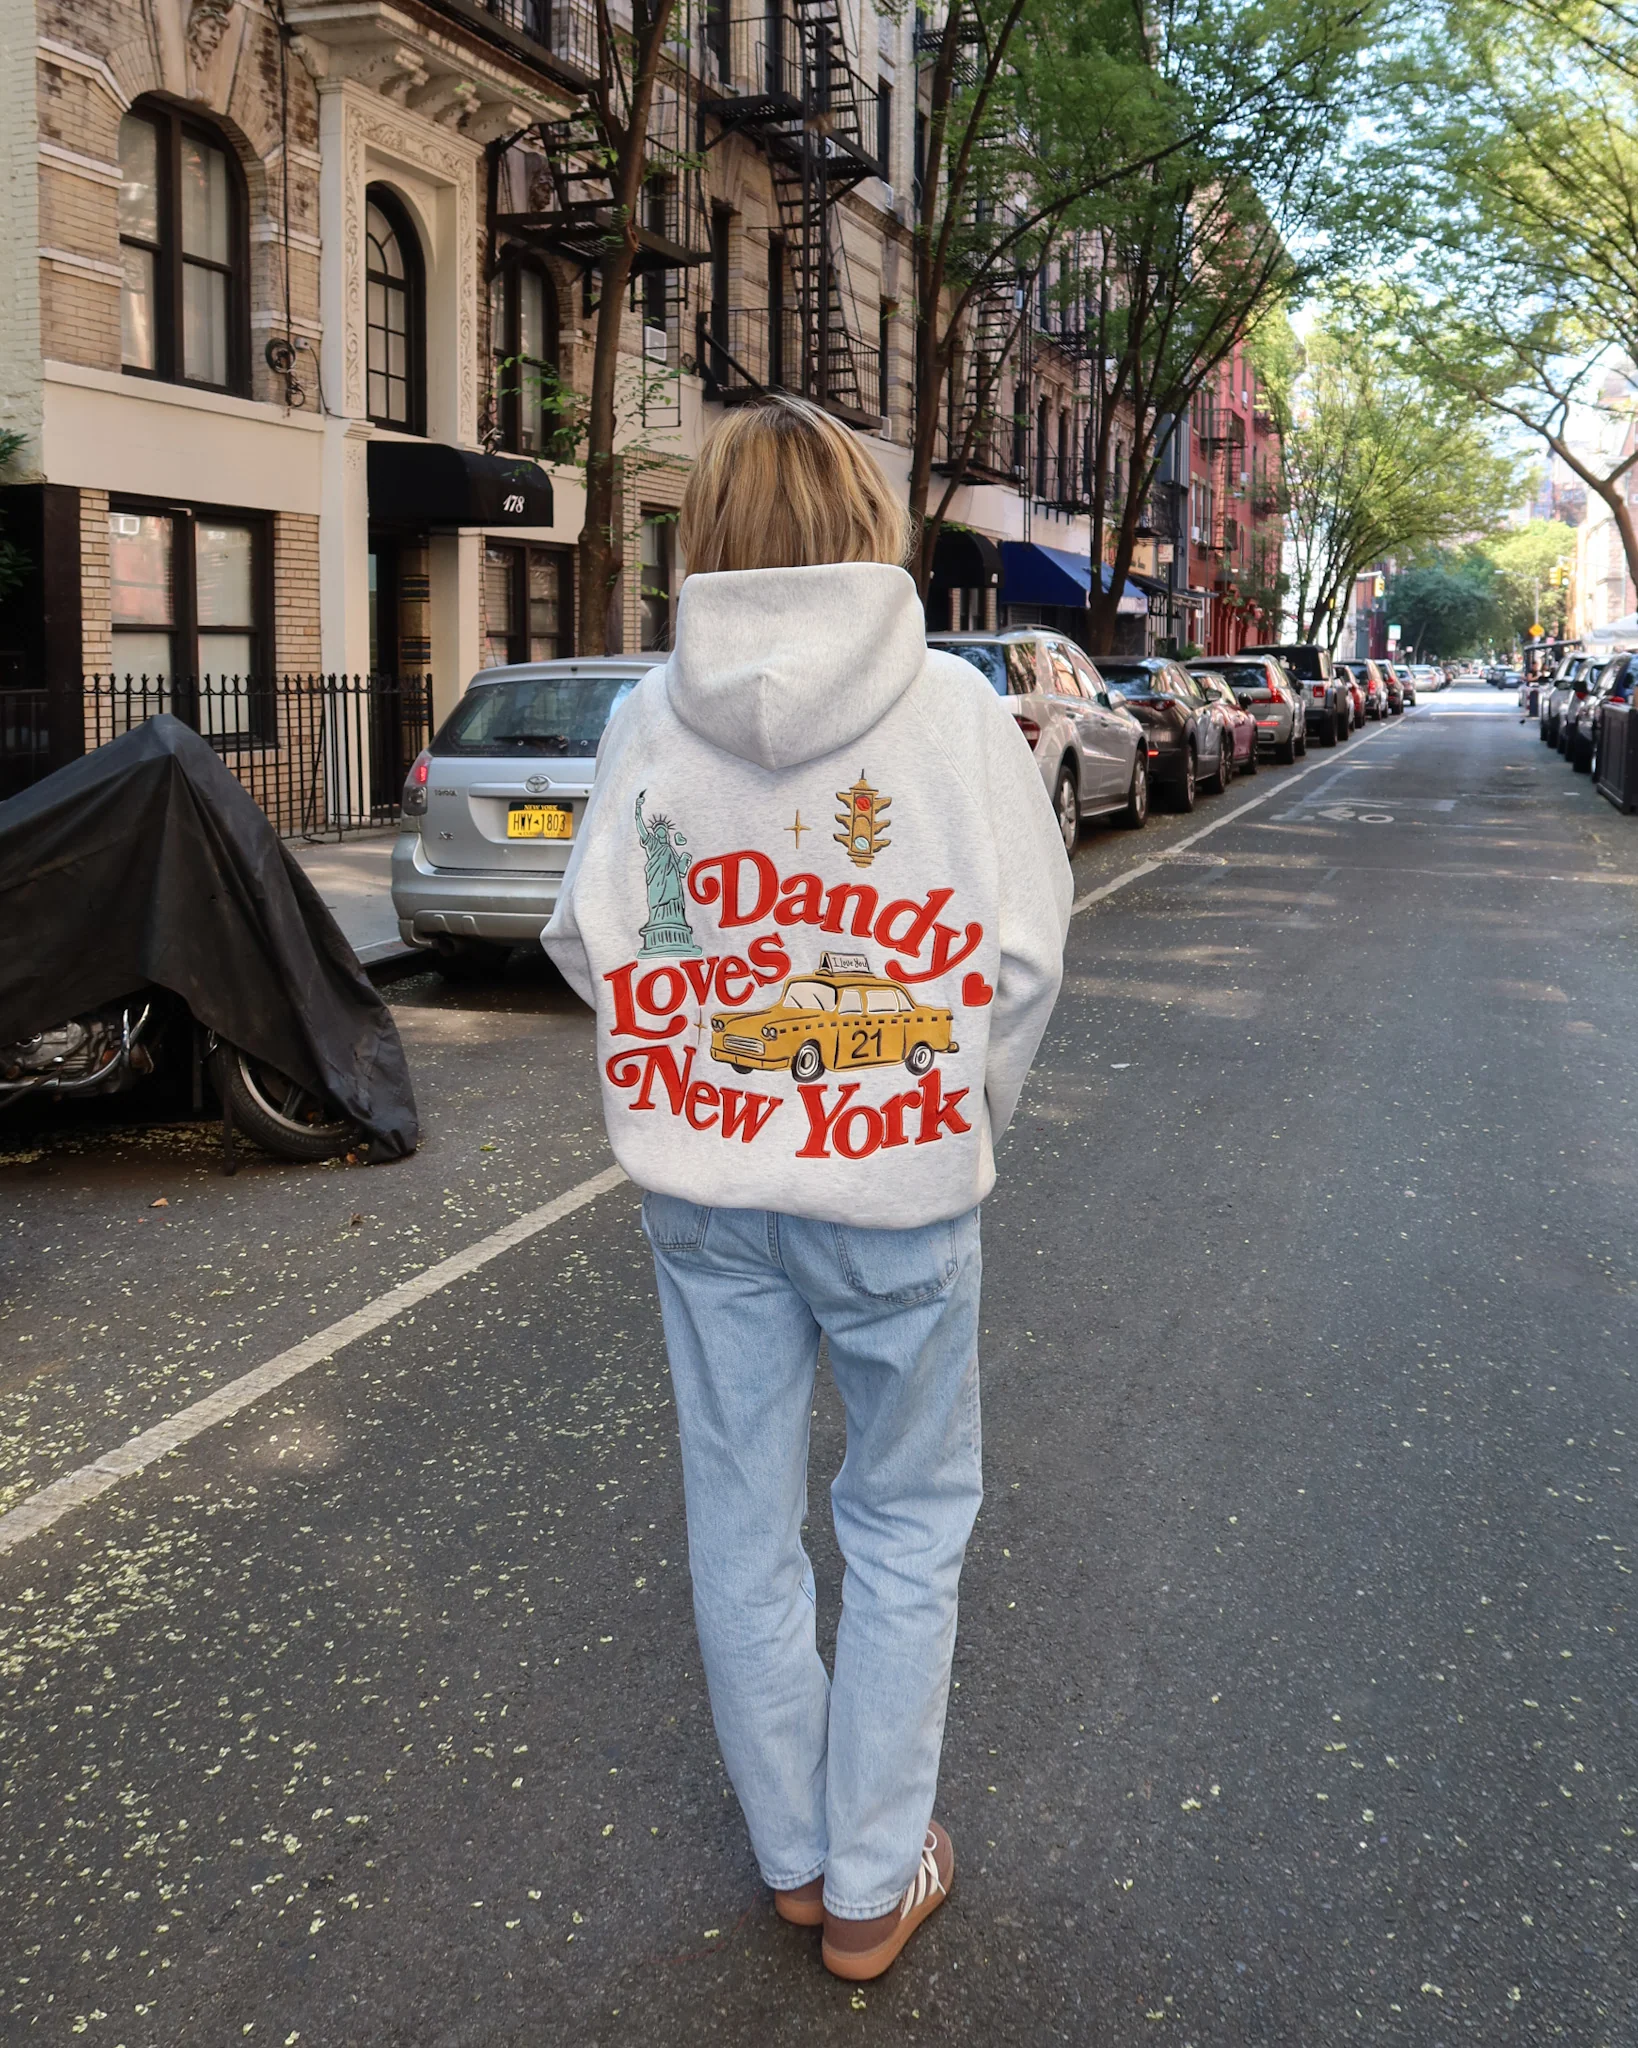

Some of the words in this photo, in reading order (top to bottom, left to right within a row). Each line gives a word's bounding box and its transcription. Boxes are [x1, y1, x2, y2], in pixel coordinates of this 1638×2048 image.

[503, 495, 525, 513] 178
[541, 813, 566, 832] 1803
[687, 849, 984, 985] Dandy
[832, 957, 840, 968] I
[840, 957, 854, 969] Love
[854, 957, 867, 969] You
[603, 931, 792, 1040] Loves
[852, 1028, 883, 1059] 21
[605, 1044, 784, 1143] New
[795, 1067, 972, 1160] York
